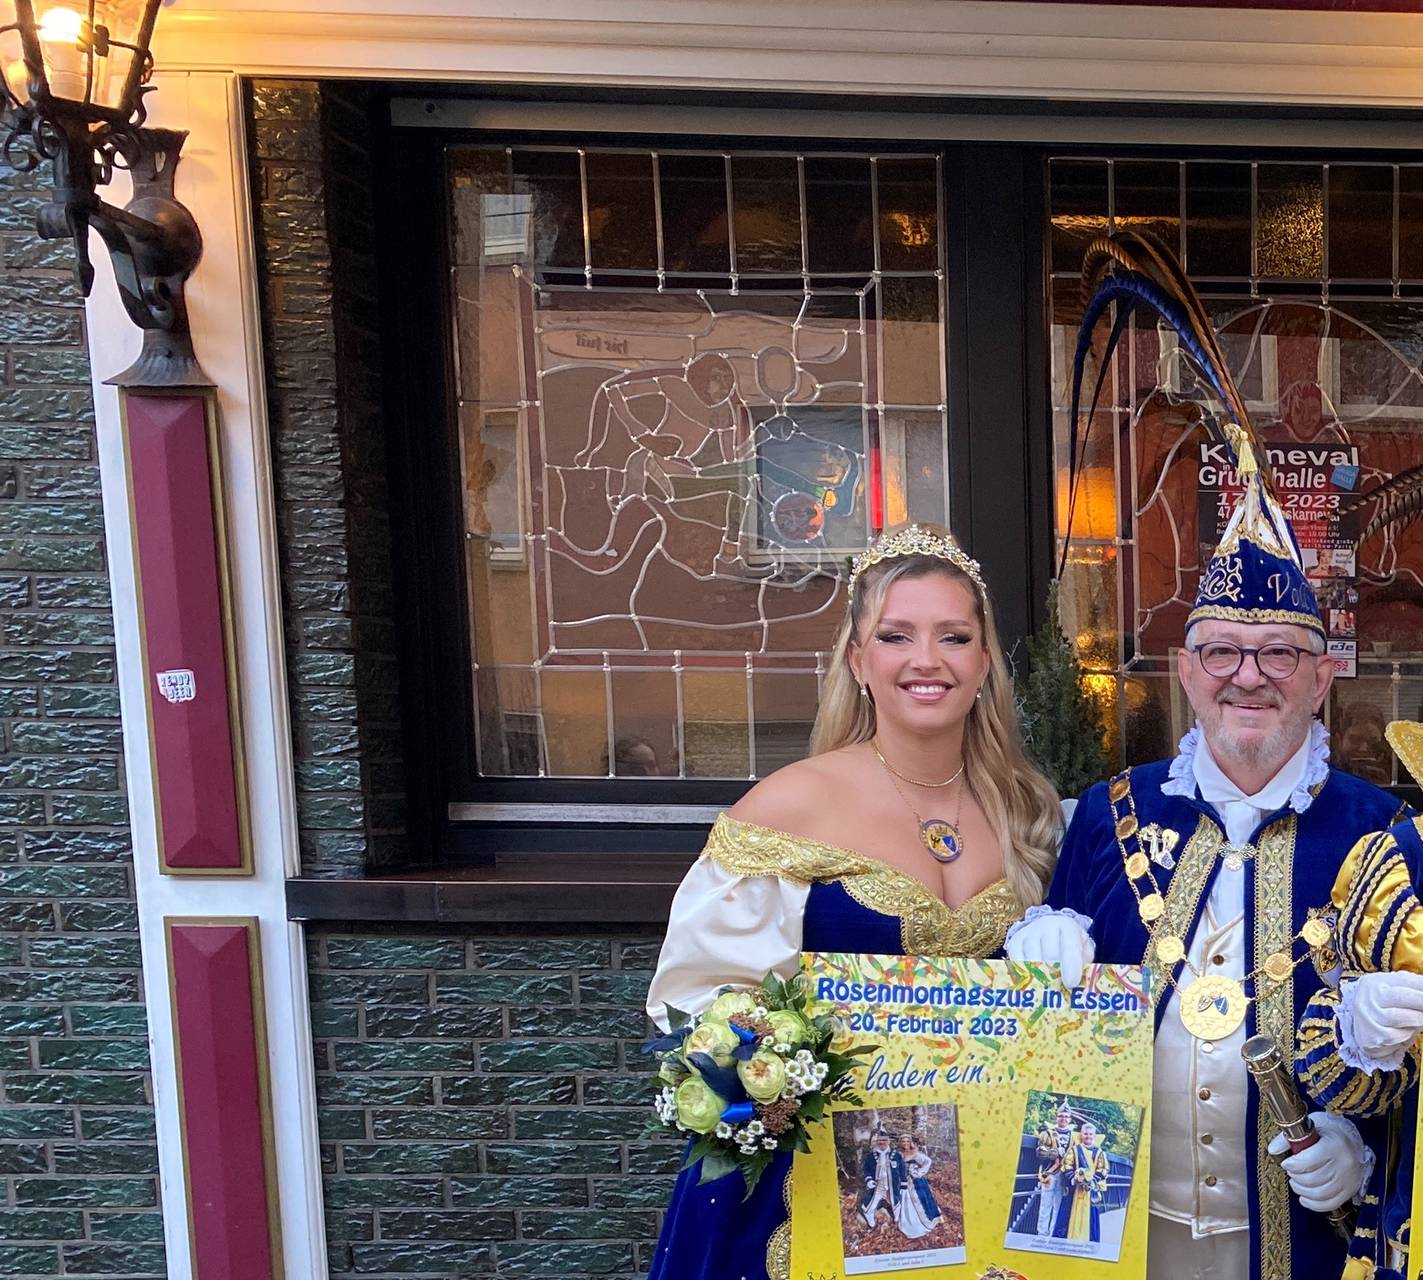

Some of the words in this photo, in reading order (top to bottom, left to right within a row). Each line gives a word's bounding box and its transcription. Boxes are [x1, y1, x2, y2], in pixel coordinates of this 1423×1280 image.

[1201, 443, 1359, 467] Kneval
[818, 978, 1035, 1008] Rosenmontagszug
[1043, 986, 1061, 1008] in
[1070, 987, 1138, 1011] Essen
[850, 1012, 881, 1032] 20.
[887, 1014, 963, 1035] Februar
[969, 1017, 1017, 1037] 2023
[865, 1055, 936, 1092] laden
